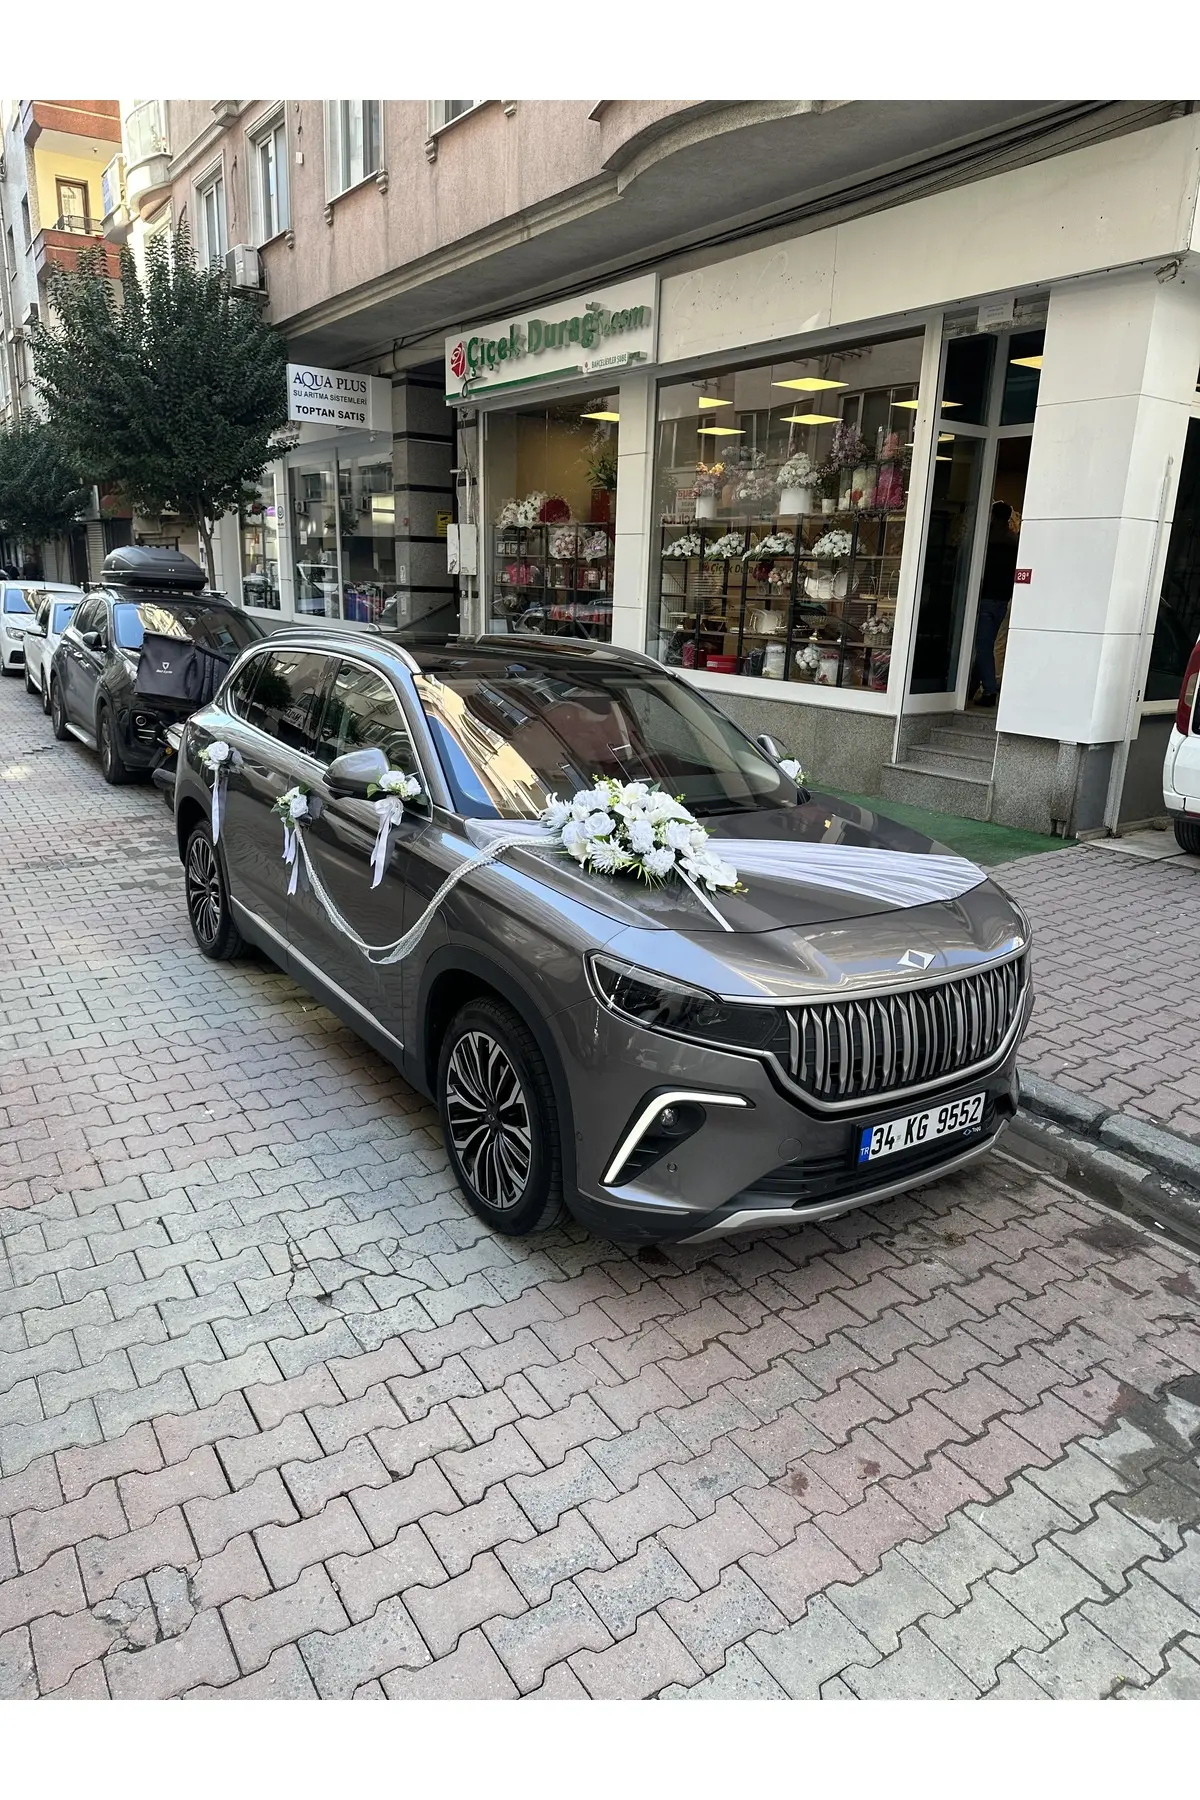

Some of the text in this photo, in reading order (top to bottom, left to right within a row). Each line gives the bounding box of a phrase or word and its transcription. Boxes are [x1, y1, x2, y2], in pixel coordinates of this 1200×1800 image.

[467, 323, 526, 377] Çiçek
[293, 371, 367, 393] AQUA PLUS
[293, 389, 367, 406] SU ARITMA SİSTEMLERİ
[295, 405, 366, 423] TOPTAN SATIŞ
[860, 1096, 982, 1156] TR 34 KG 9552
